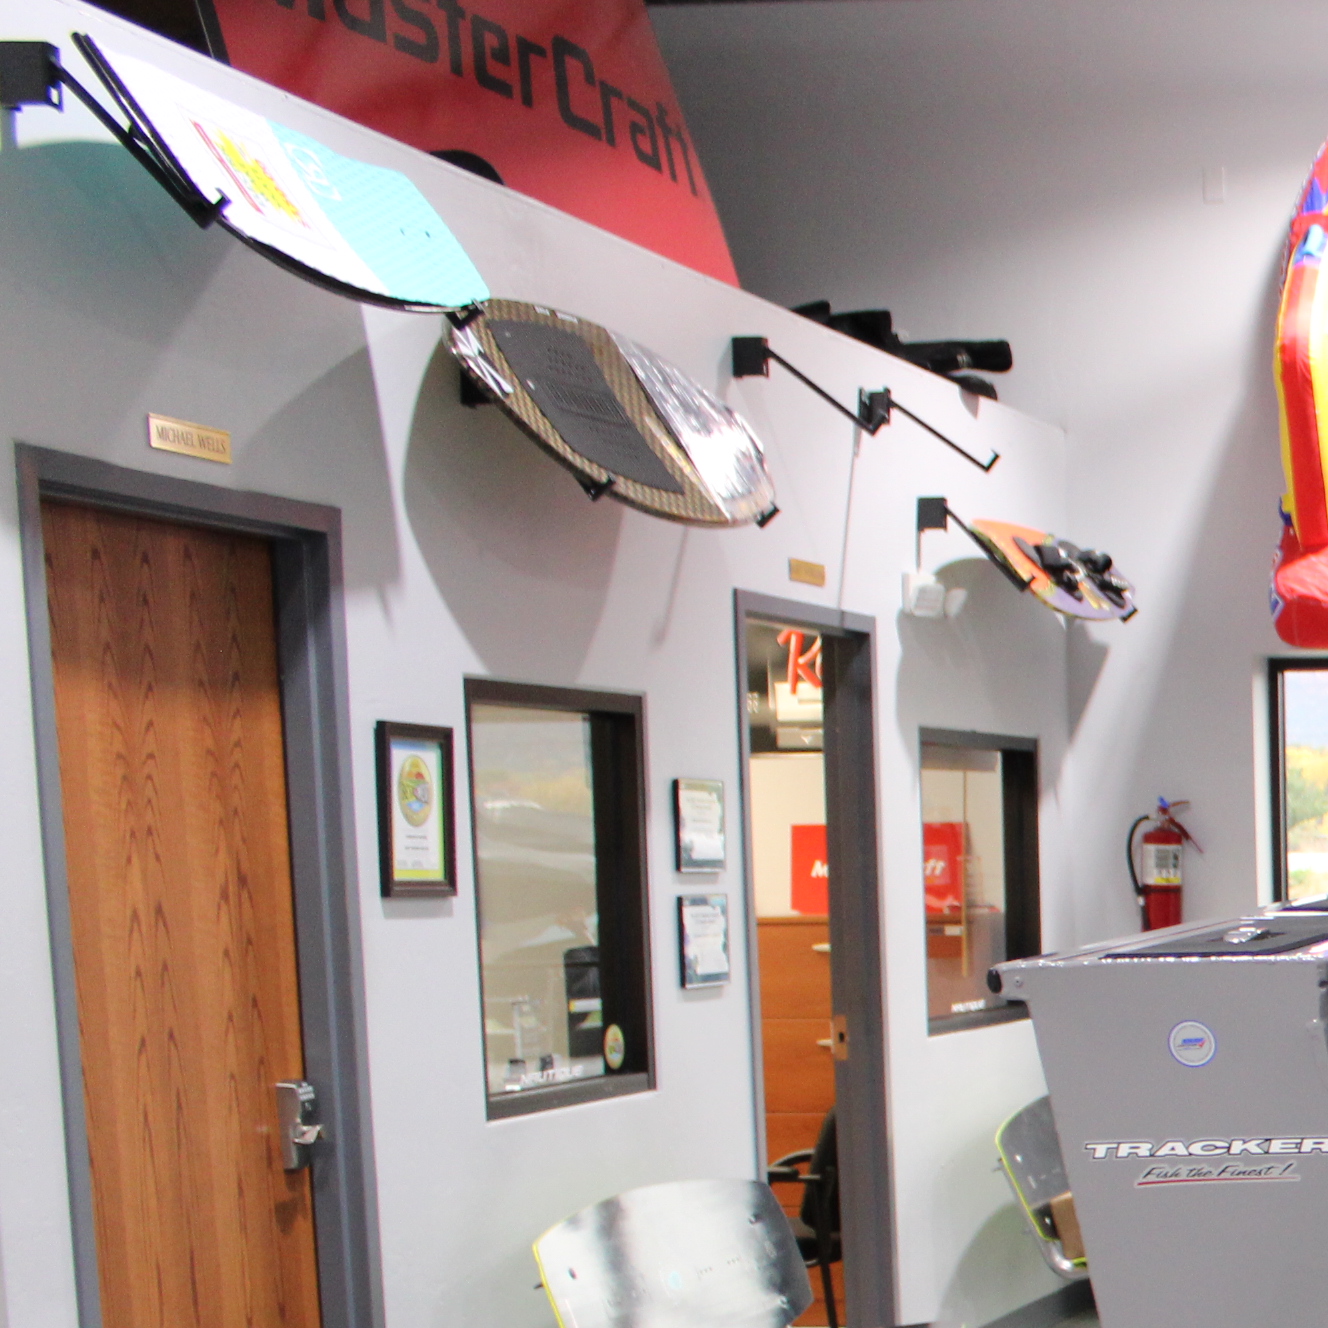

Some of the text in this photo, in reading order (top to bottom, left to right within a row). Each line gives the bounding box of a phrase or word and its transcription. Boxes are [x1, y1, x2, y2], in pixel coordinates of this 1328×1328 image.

[279, 0, 698, 197] asterCraft
[1142, 1166, 1182, 1180] Fish
[1185, 1166, 1214, 1178] the
